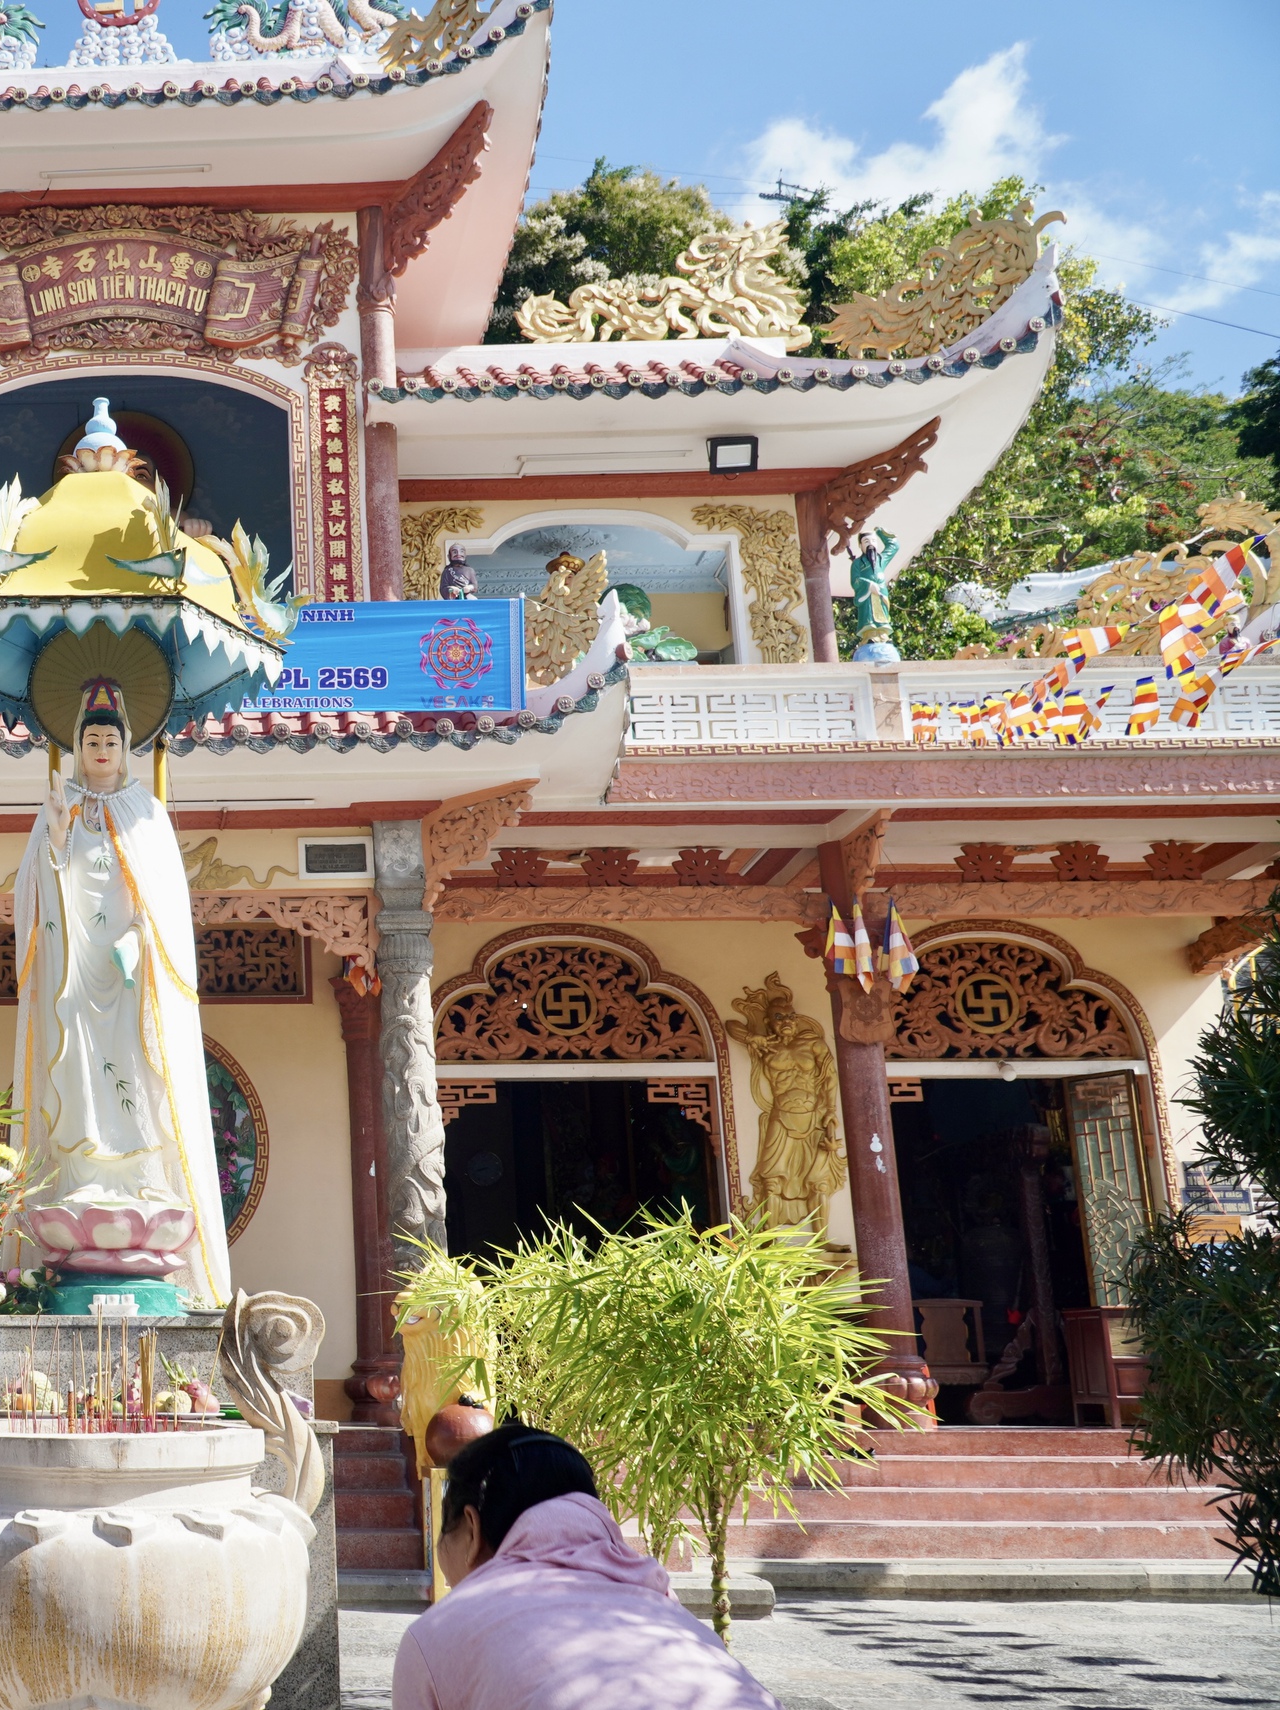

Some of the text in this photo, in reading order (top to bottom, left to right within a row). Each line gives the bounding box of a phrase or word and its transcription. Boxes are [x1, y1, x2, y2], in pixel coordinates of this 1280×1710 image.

[29, 271, 211, 317] LINH SƠN TIÊN THẠCH TỰ
[302, 609, 355, 622] NINH
[318, 667, 388, 689] 2569
[242, 697, 354, 709] ELEBRATIONS
[420, 695, 480, 709] VESAK
